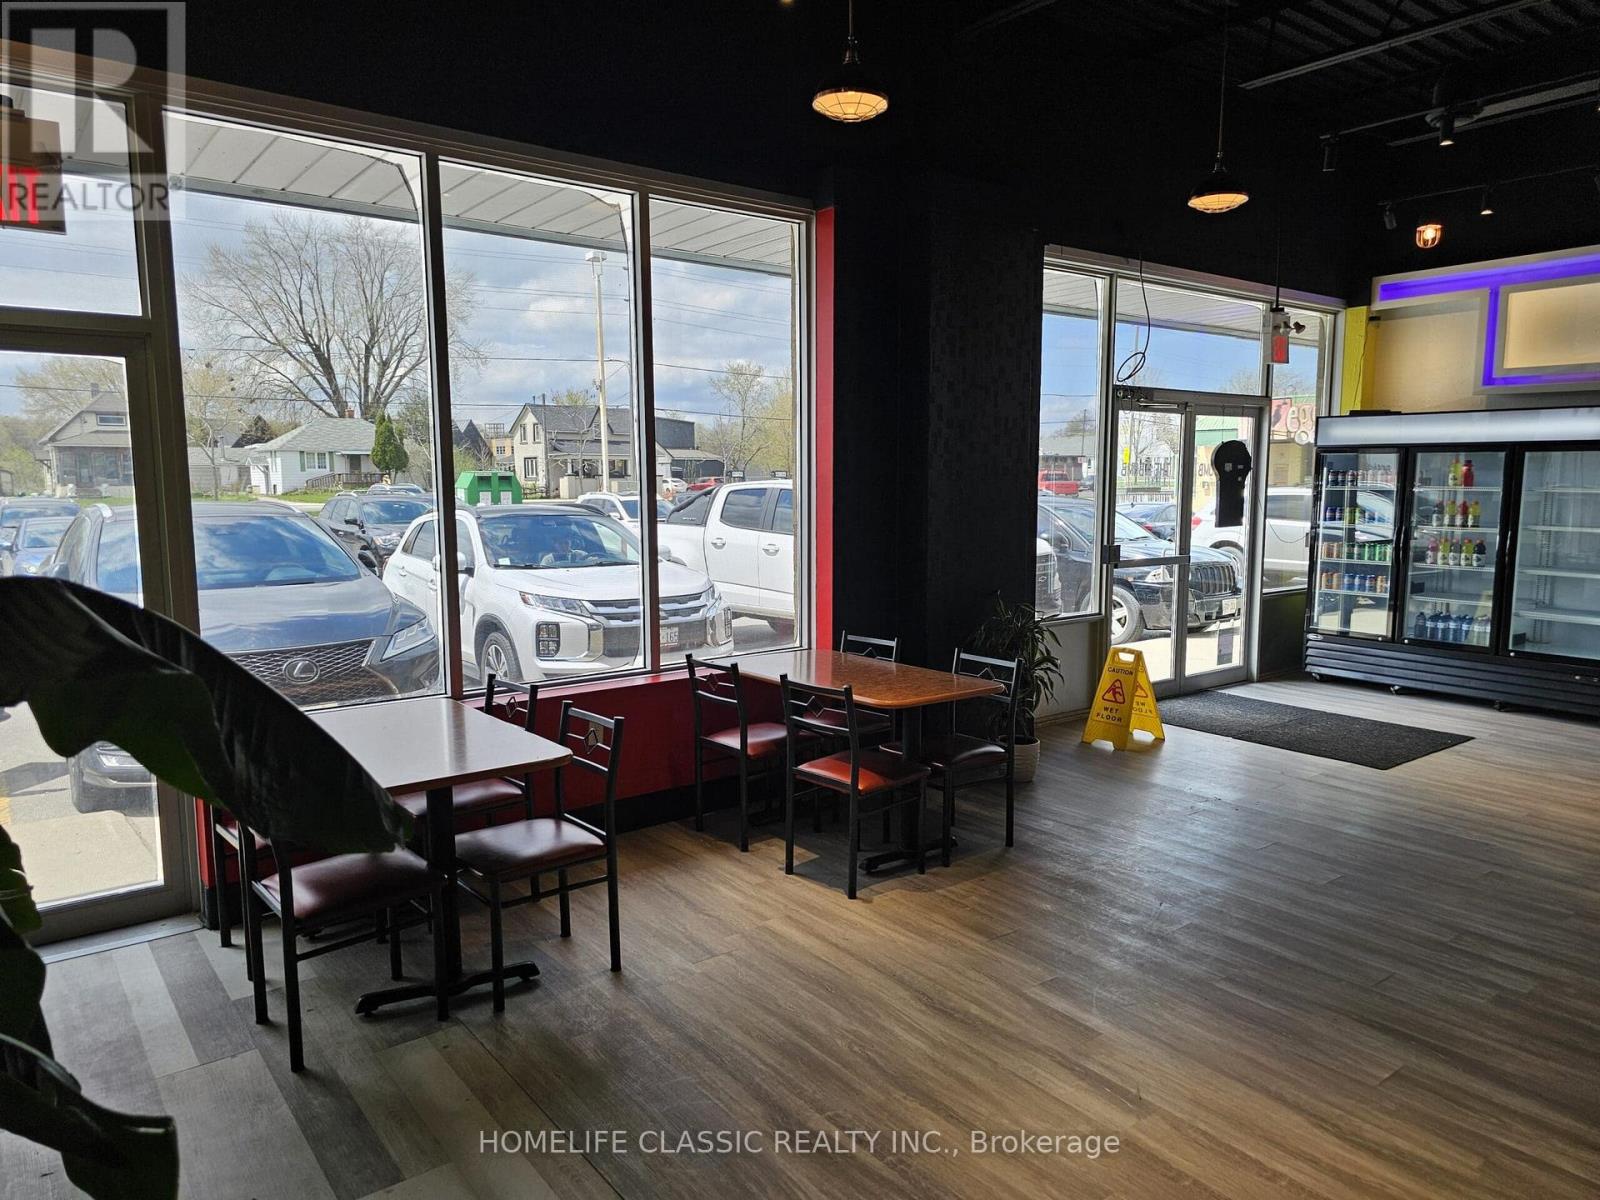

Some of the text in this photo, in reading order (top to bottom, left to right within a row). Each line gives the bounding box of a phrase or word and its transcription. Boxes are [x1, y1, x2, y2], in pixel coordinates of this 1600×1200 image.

[1107, 667, 1133, 676] CAUTION
[1103, 706, 1119, 714] WET
[1096, 712, 1122, 723] FLOOR
